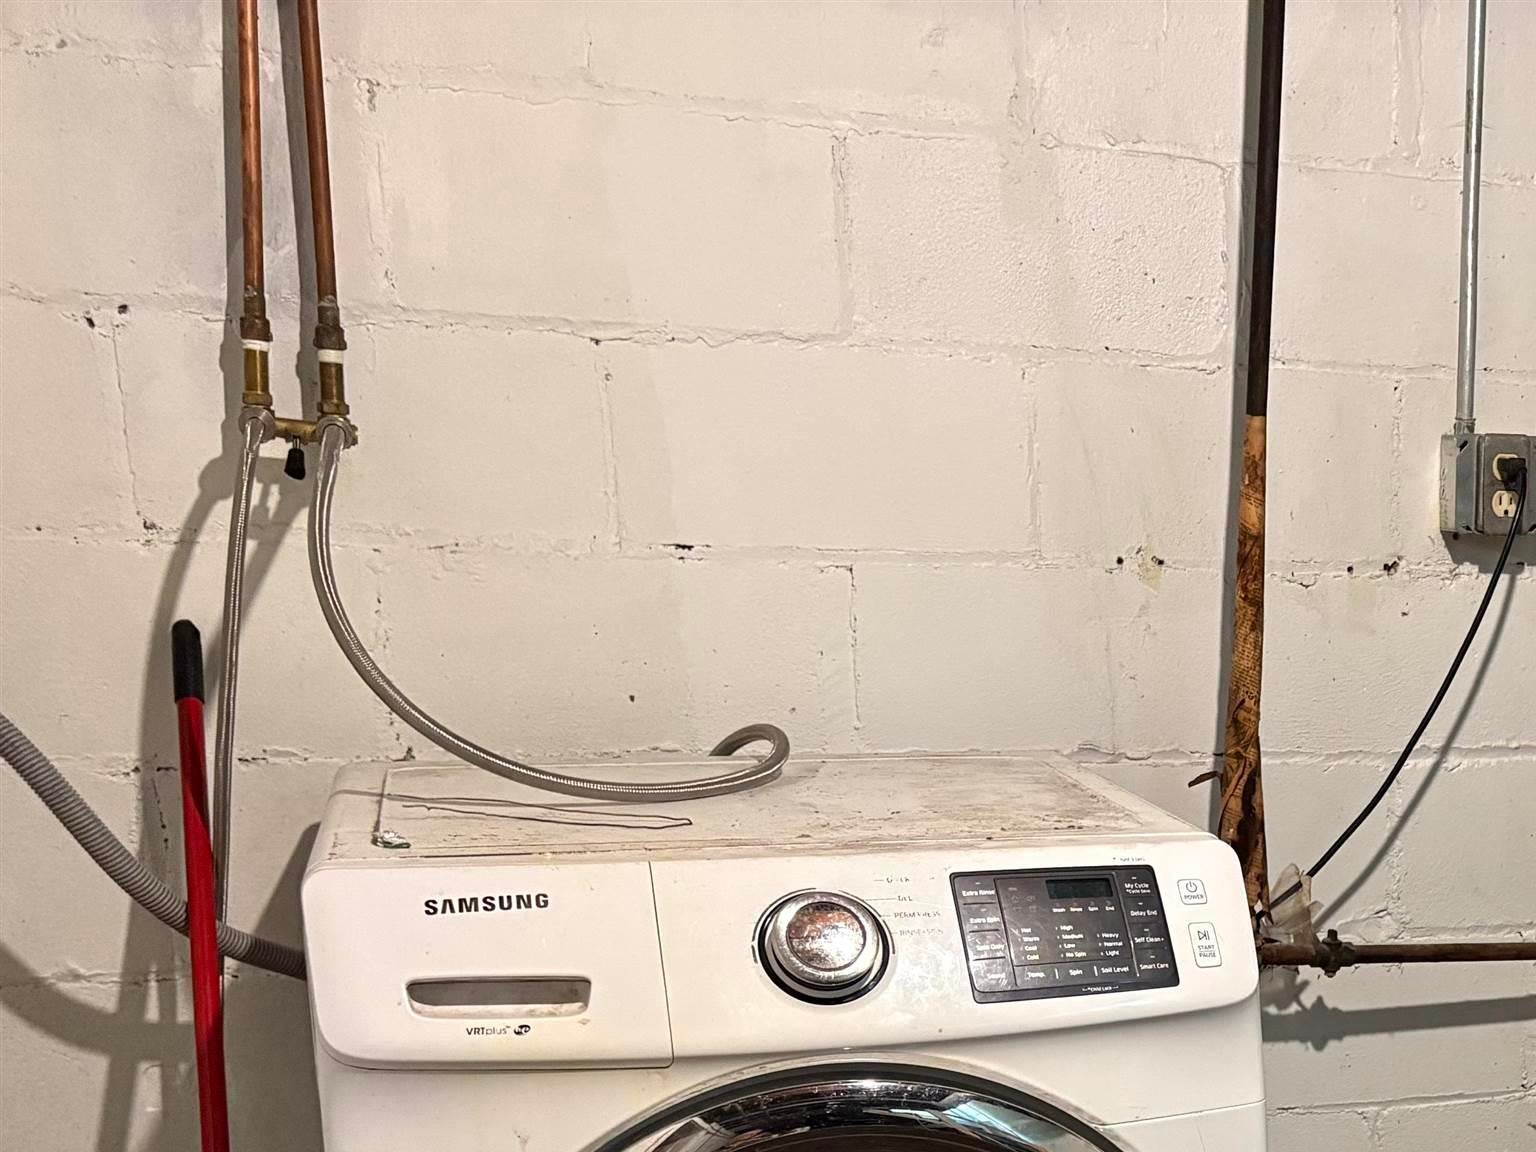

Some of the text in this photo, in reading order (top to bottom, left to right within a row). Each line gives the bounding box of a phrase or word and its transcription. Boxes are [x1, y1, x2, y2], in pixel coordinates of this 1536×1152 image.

[424, 893, 550, 915] SAMSUNG
[1105, 949, 1120, 957] Light
[1113, 965, 1130, 973] Level
[1139, 963, 1157, 971] Smart
[1069, 969, 1083, 977] Spin
